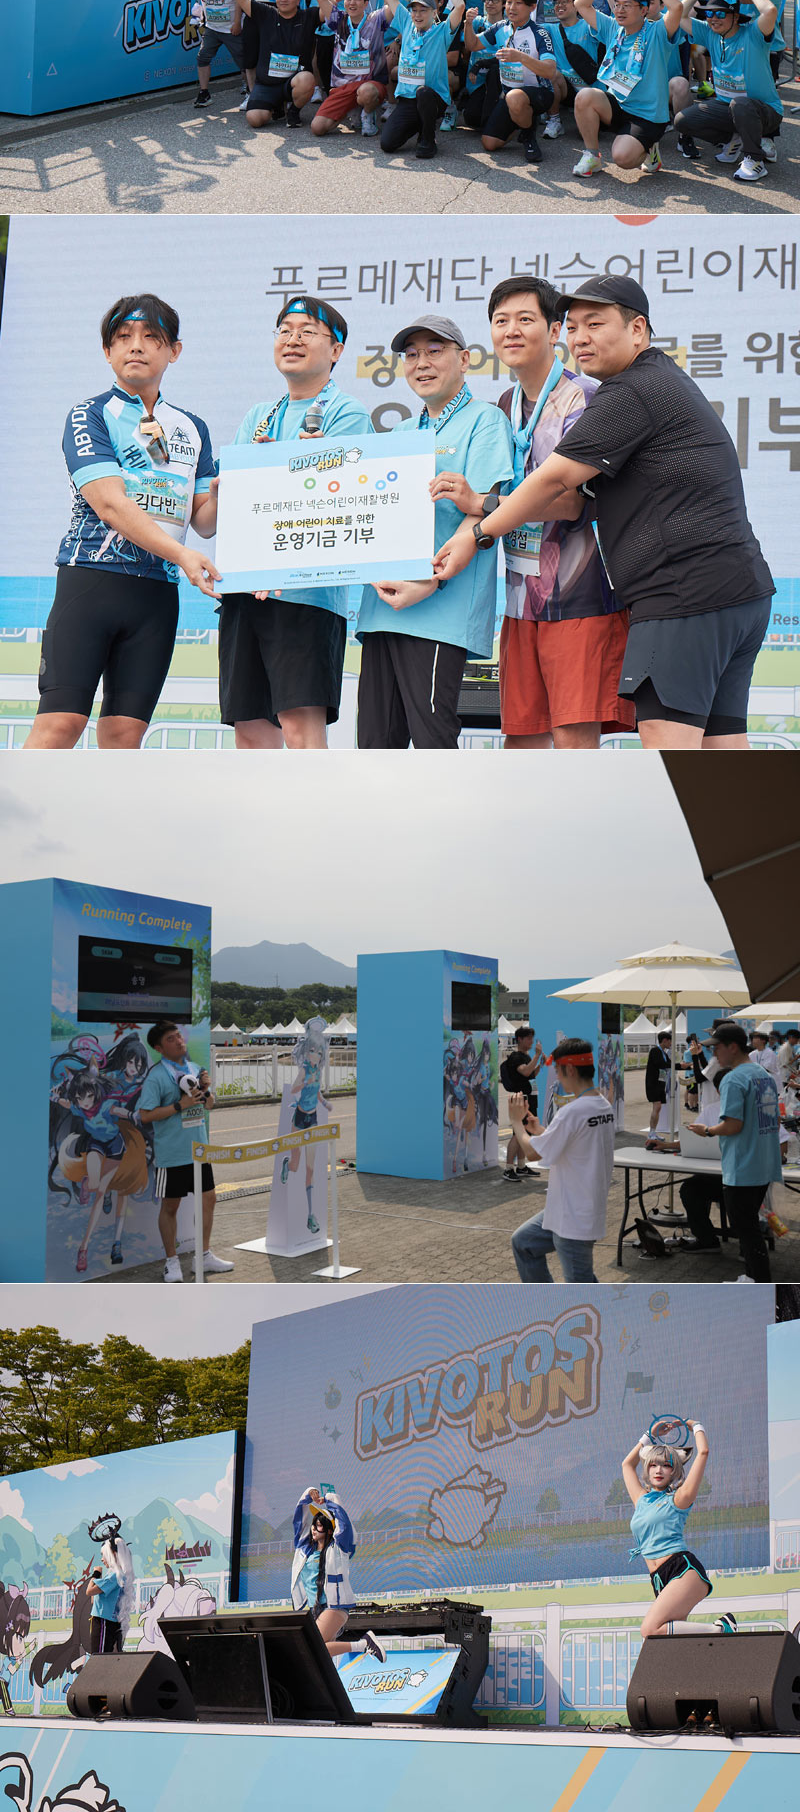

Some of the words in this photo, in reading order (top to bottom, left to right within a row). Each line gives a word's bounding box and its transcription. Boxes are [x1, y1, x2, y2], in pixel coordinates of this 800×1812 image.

[264, 257, 494, 308] 푸르메재단
[168, 443, 196, 457] TEAM
[289, 448, 343, 472] KIVOTOS
[317, 458, 343, 472] RUN
[135, 492, 177, 515] 김다반
[251, 498, 304, 515] 푸르메재단
[305, 491, 401, 510] 넥슨어린이재활병원
[274, 519, 294, 531] 장애
[296, 517, 324, 528] 어린이
[325, 515, 353, 527] 치료를
[356, 513, 376, 525] 위한
[272, 529, 338, 552] 운영기금
[343, 527, 376, 545] 기부
[81, 902, 136, 927] Running
[138, 911, 193, 932] Complete
[206, 1149, 231, 1161] FINISH
[246, 1145, 269, 1157] FINISH
[360, 1308, 595, 1454] KIVOTOS
[474, 1358, 590, 1445] RUN
[350, 1669, 410, 1690] KIVOTOS
[375, 1678, 406, 1693] RUN
